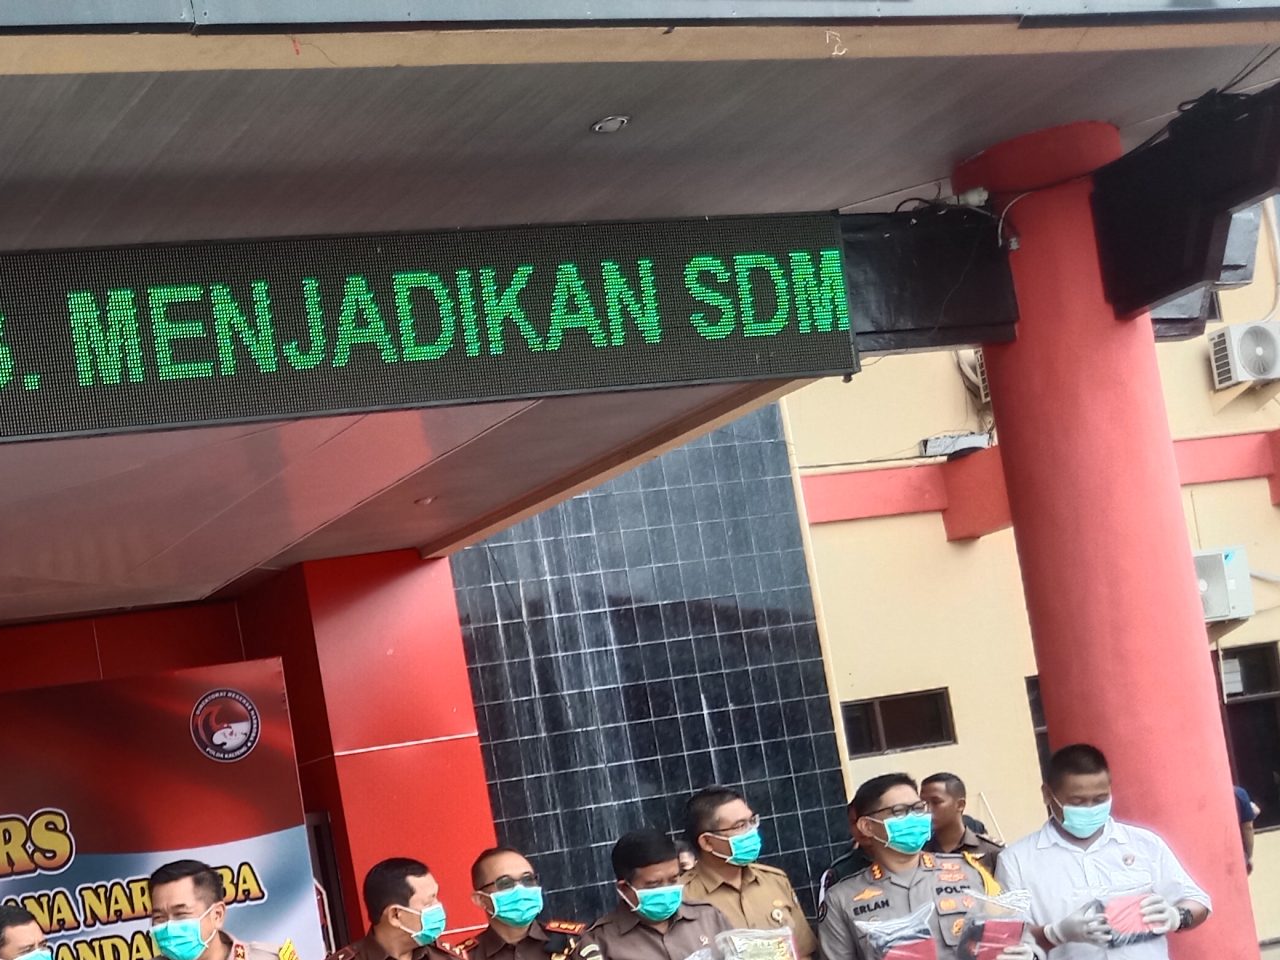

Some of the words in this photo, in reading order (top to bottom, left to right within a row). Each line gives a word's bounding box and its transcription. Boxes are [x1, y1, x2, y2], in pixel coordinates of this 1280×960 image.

[65, 259, 661, 386] MENJADIKAN
[683, 250, 850, 341] SDM
[78, 862, 266, 925] NARBA
